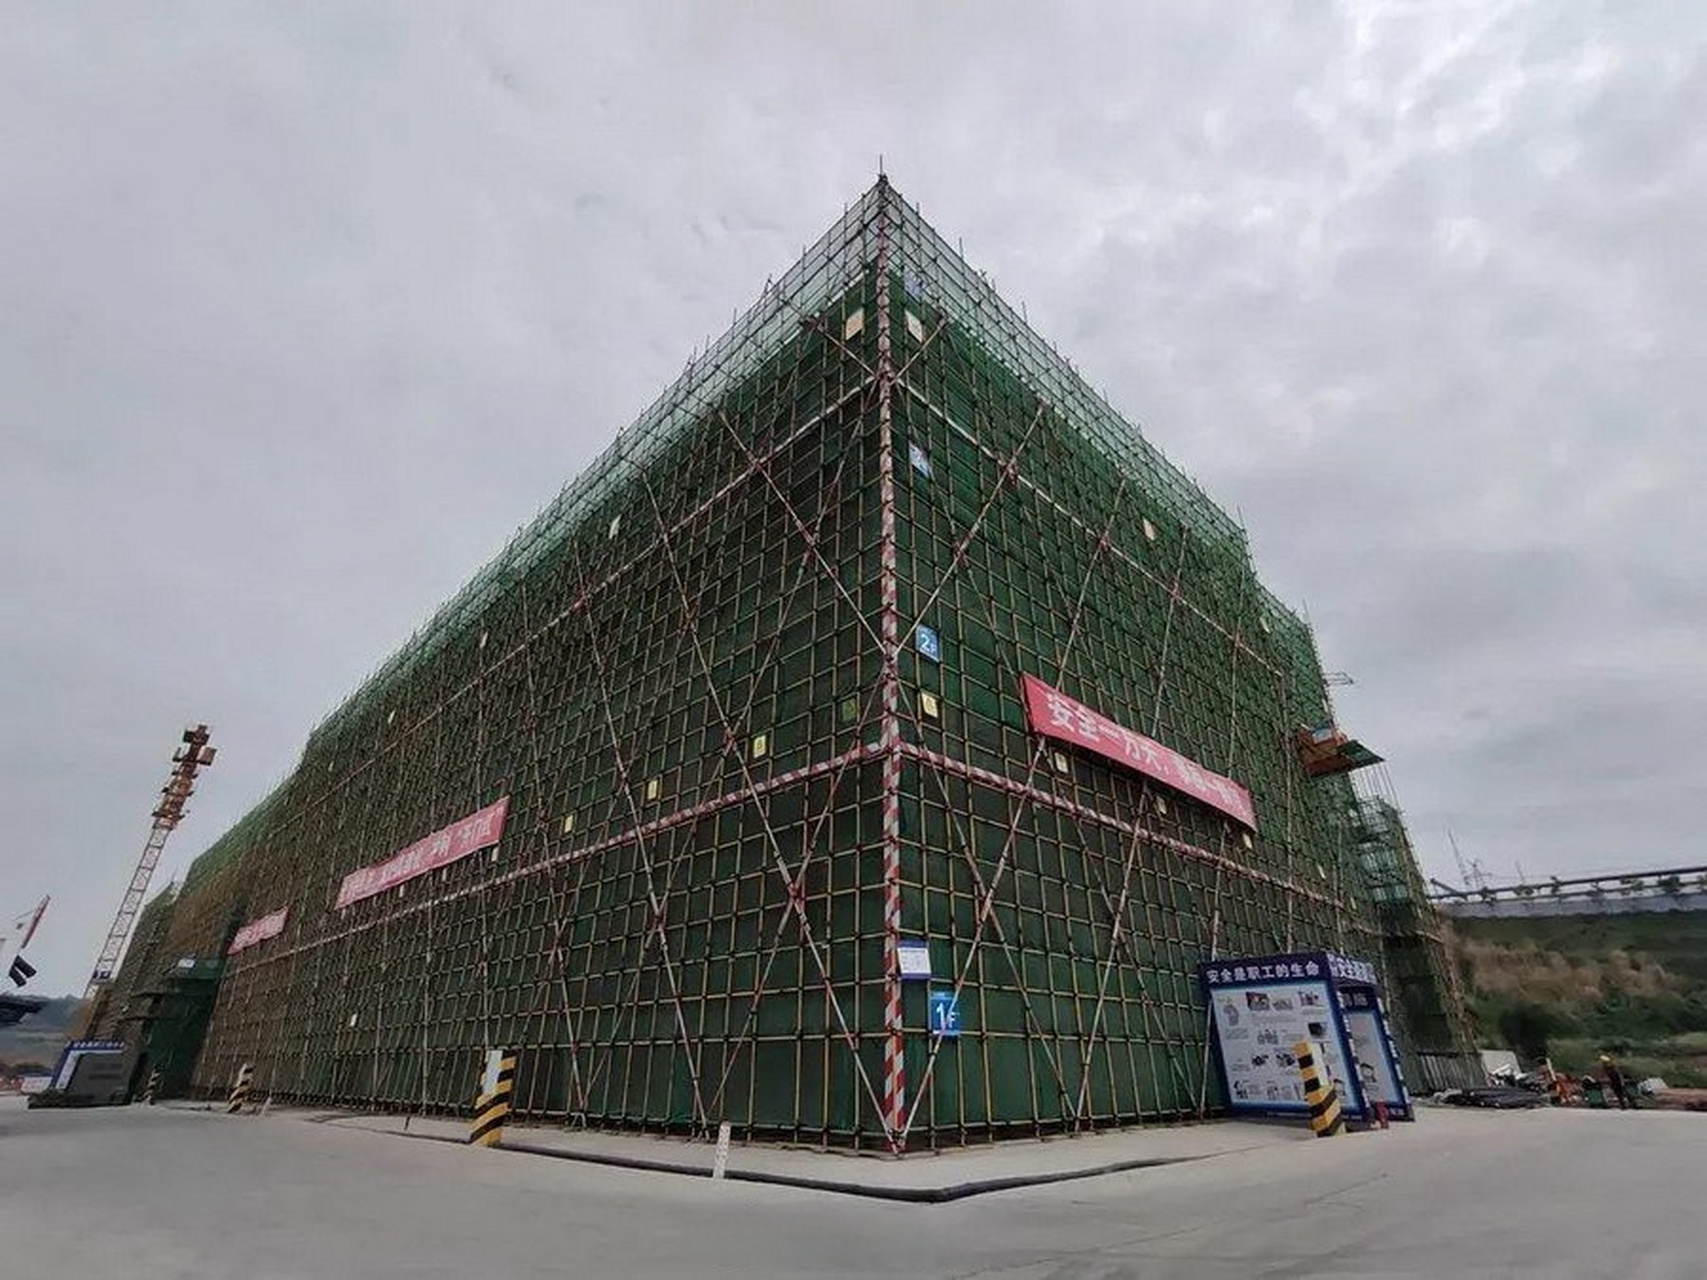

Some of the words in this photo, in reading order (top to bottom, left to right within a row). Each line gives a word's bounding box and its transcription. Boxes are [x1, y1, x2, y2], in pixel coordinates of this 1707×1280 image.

[1206, 960, 1320, 983] 安全是职工的生命
